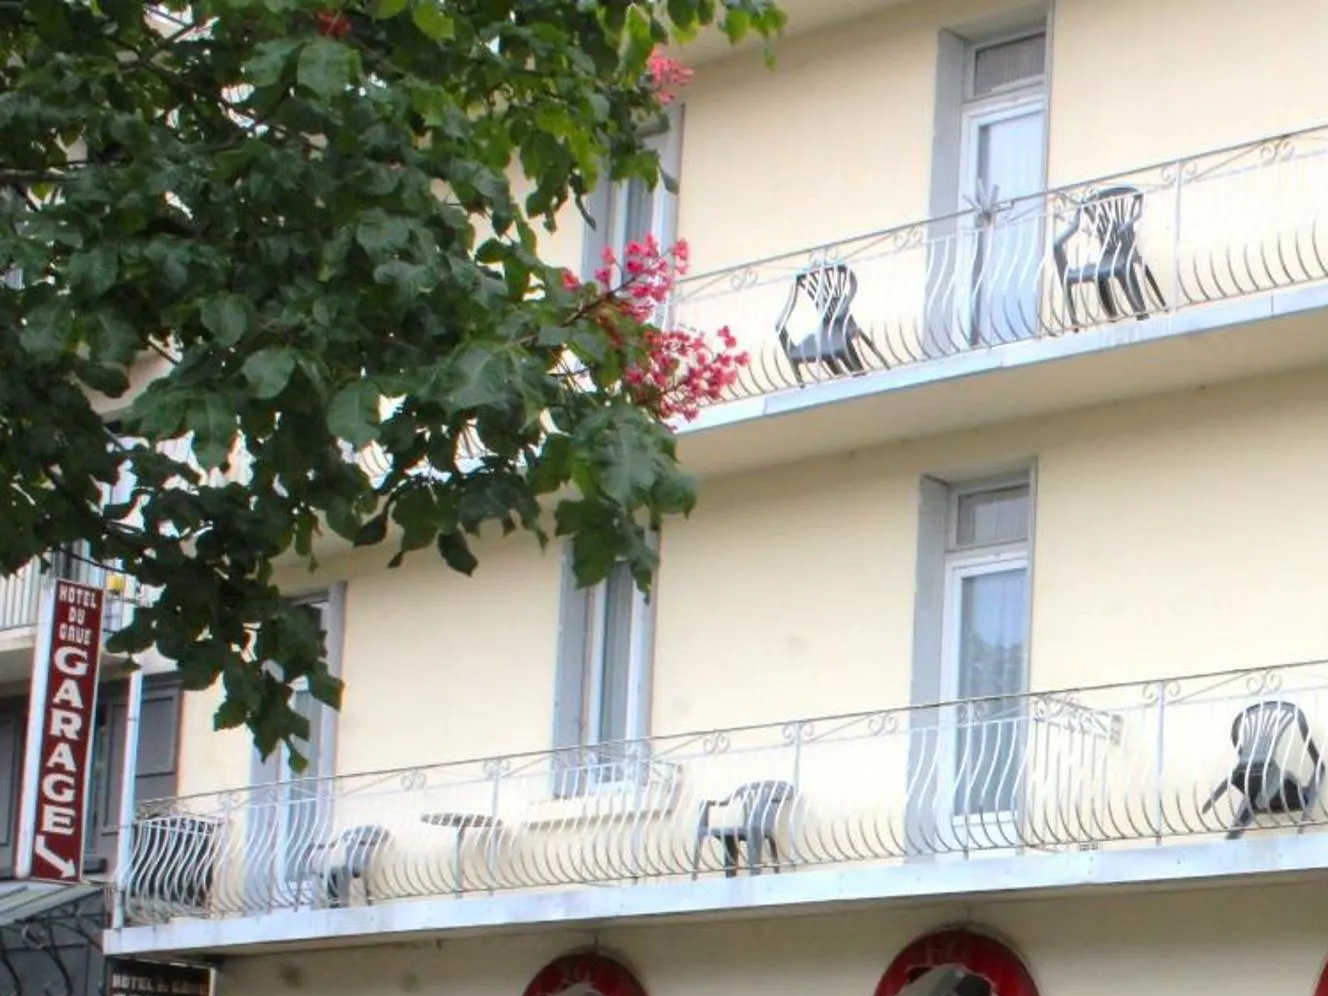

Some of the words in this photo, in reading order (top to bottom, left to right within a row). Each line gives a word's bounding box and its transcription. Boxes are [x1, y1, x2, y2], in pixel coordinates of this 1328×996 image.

[59, 584, 97, 609] HOTEL
[68, 605, 86, 625] DU
[42, 646, 89, 836] GARAGE
